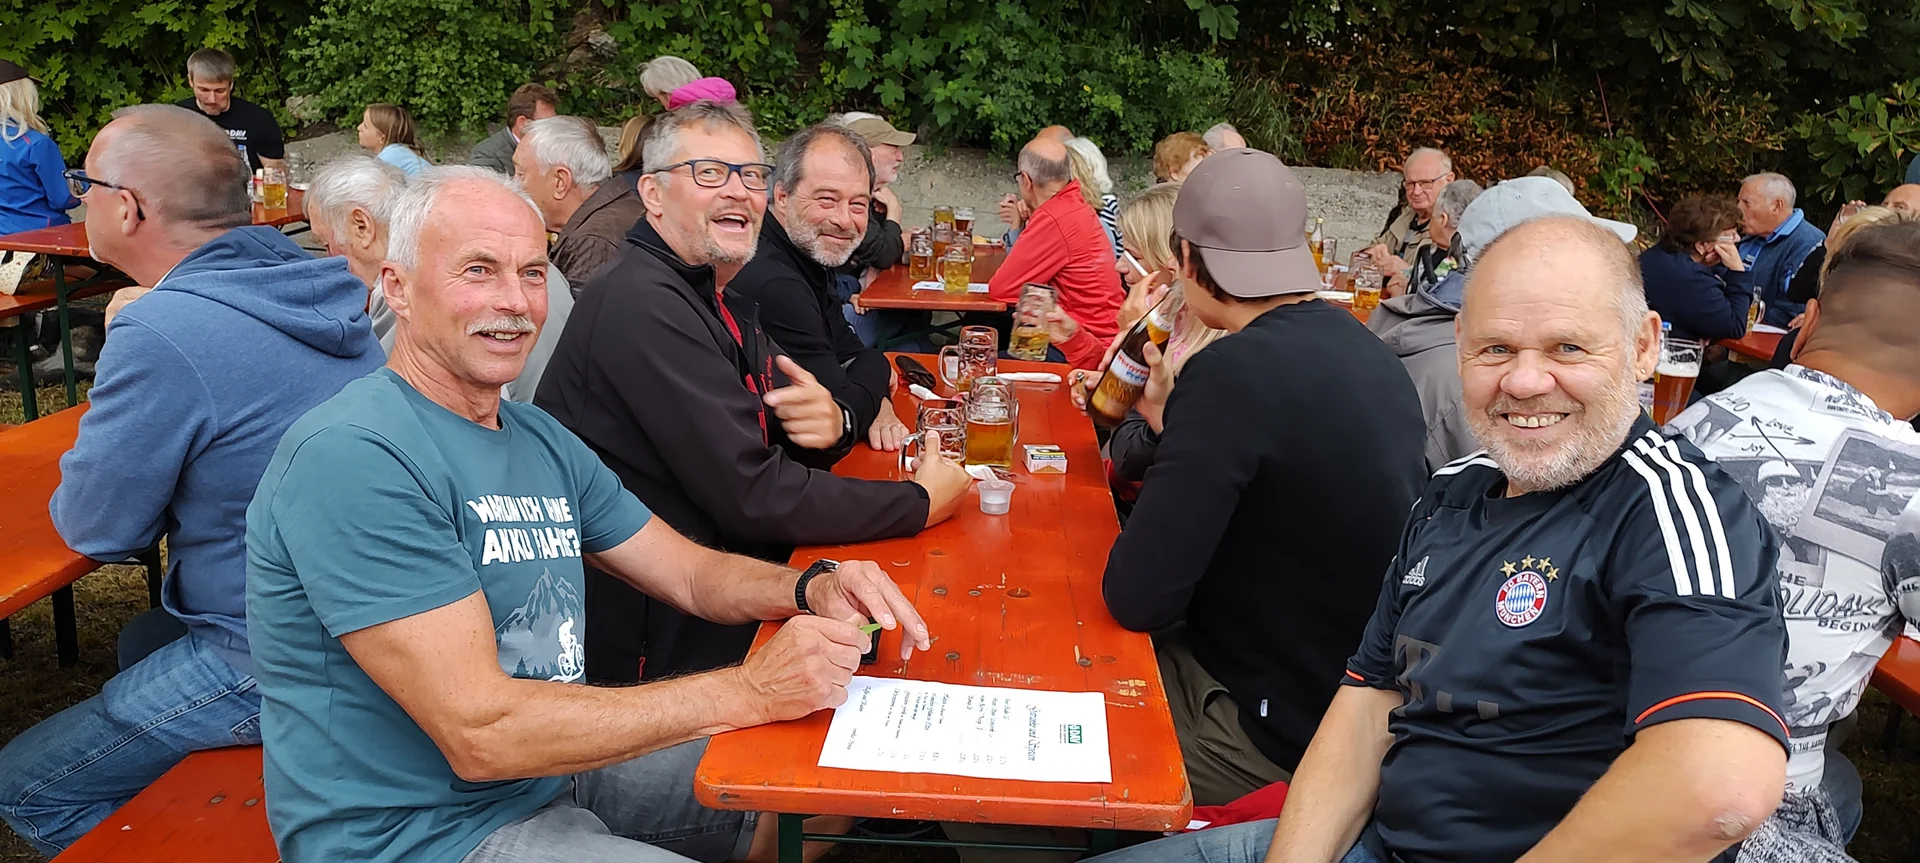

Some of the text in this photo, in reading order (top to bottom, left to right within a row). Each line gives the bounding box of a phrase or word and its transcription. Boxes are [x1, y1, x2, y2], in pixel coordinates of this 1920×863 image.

[515, 496, 545, 522] ICH
[481, 527, 536, 566] AKKU
[1516, 573, 1545, 599] BAYERN
[1779, 570, 1808, 587] HE
[1780, 585, 1887, 618] OLIDAYS
